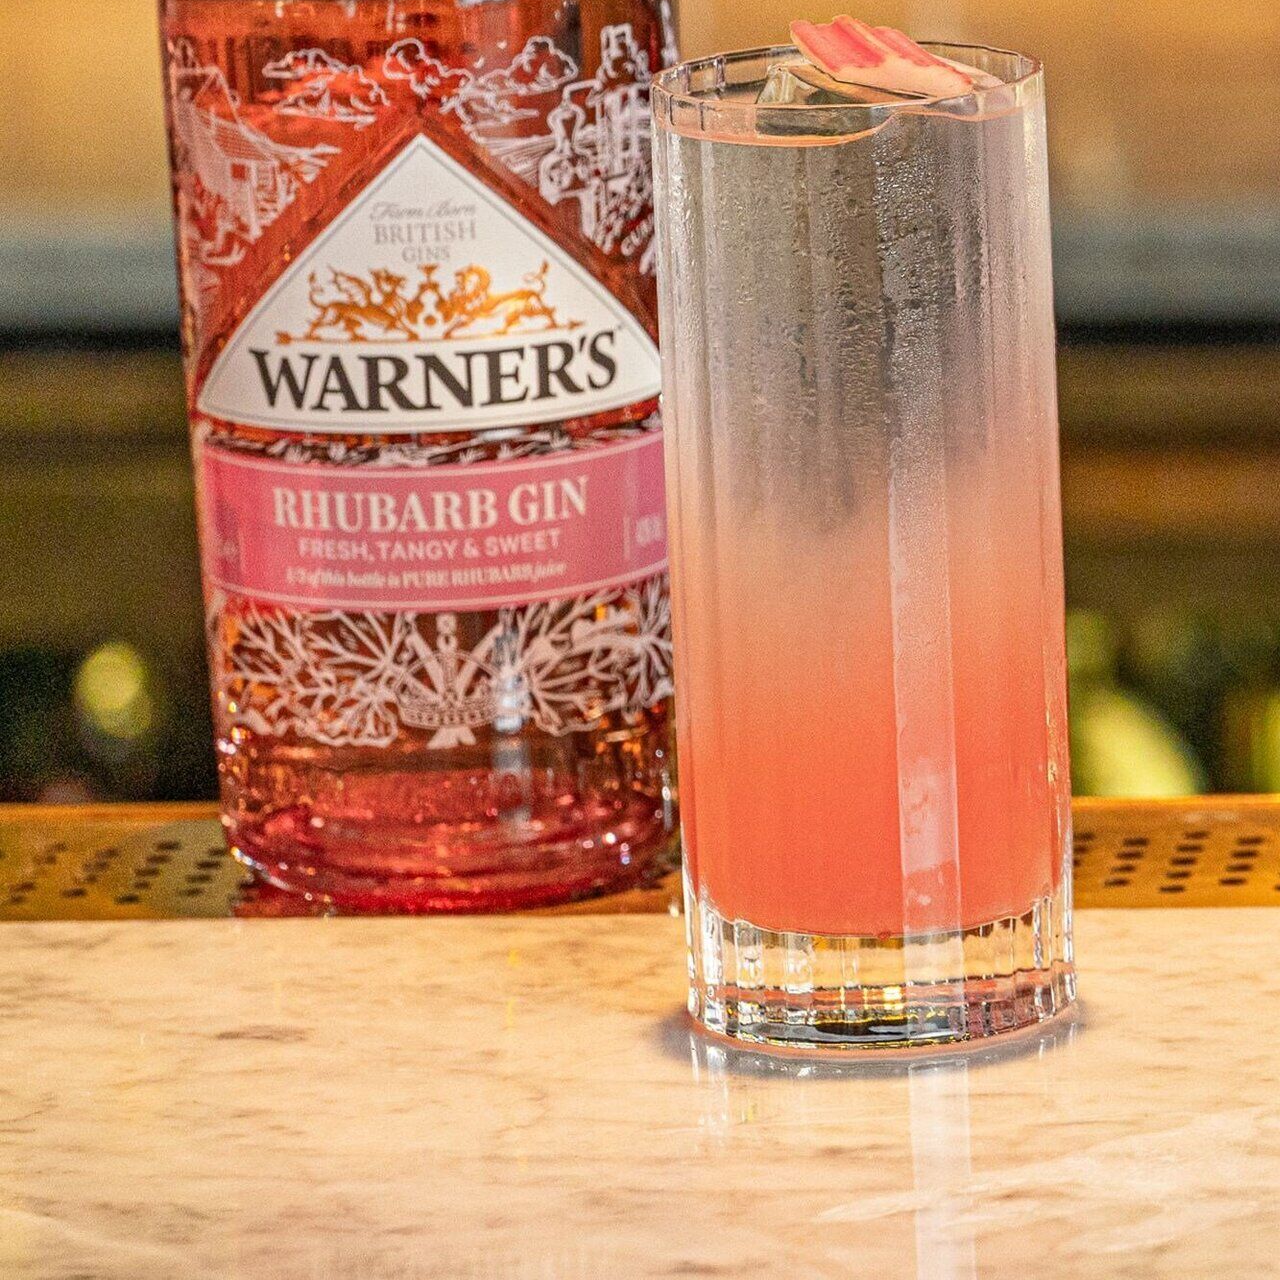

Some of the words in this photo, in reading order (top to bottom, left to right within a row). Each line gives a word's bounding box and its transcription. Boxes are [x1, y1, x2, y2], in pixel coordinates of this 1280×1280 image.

[374, 222, 477, 246] BRITISH
[401, 245, 451, 263] GINS
[248, 328, 619, 413] WARNER'S
[272, 487, 498, 533] RHUBARB
[507, 475, 589, 526] GIN
[298, 537, 375, 563] FRESH,
[374, 537, 459, 561] TANGY
[462, 537, 480, 559] &
[484, 527, 561, 557] SWEET
[402, 568, 450, 590] PURE
[451, 563, 533, 587] RHUBARB
